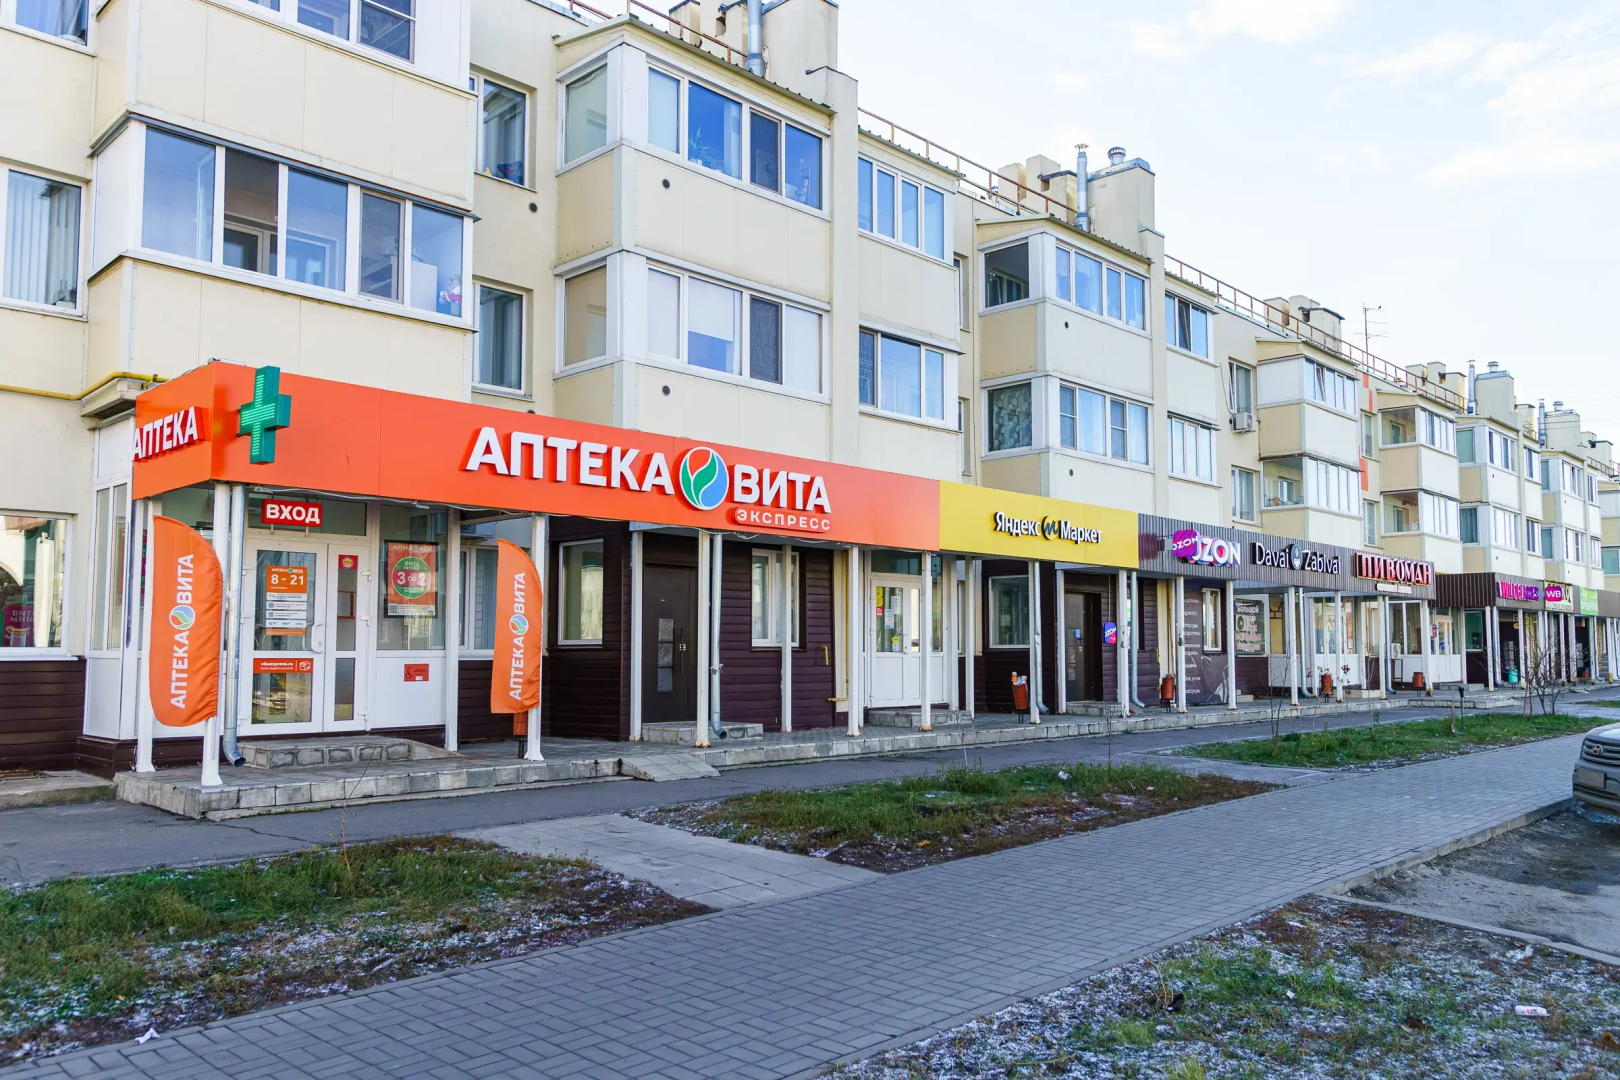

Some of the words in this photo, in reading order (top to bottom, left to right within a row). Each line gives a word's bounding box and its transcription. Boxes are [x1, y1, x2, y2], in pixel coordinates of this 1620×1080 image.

[133, 406, 198, 460] АПТЕКА
[465, 426, 675, 496] АПТЕКА
[733, 463, 832, 514] ВИТА
[265, 503, 321, 524] ВХОД
[736, 510, 832, 532] ЭКСПРЕСС
[995, 511, 1042, 537] Яндекс
[1060, 520, 1103, 545] Маркет
[1256, 542, 1289, 569] Davai
[1304, 550, 1341, 575] Zabivai
[1362, 553, 1432, 585] ПИВОМАН
[176, 552, 195, 605] ВИТА
[270, 573, 279, 585] 8
[290, 574, 304, 586] 21
[397, 571, 406, 585] 3
[417, 572, 427, 586] 2
[513, 571, 527, 616] ВИТА
[1546, 590, 1562, 598] WB
[170, 631, 195, 709] АПТЕКА
[508, 635, 525, 702] АПТЕКА
